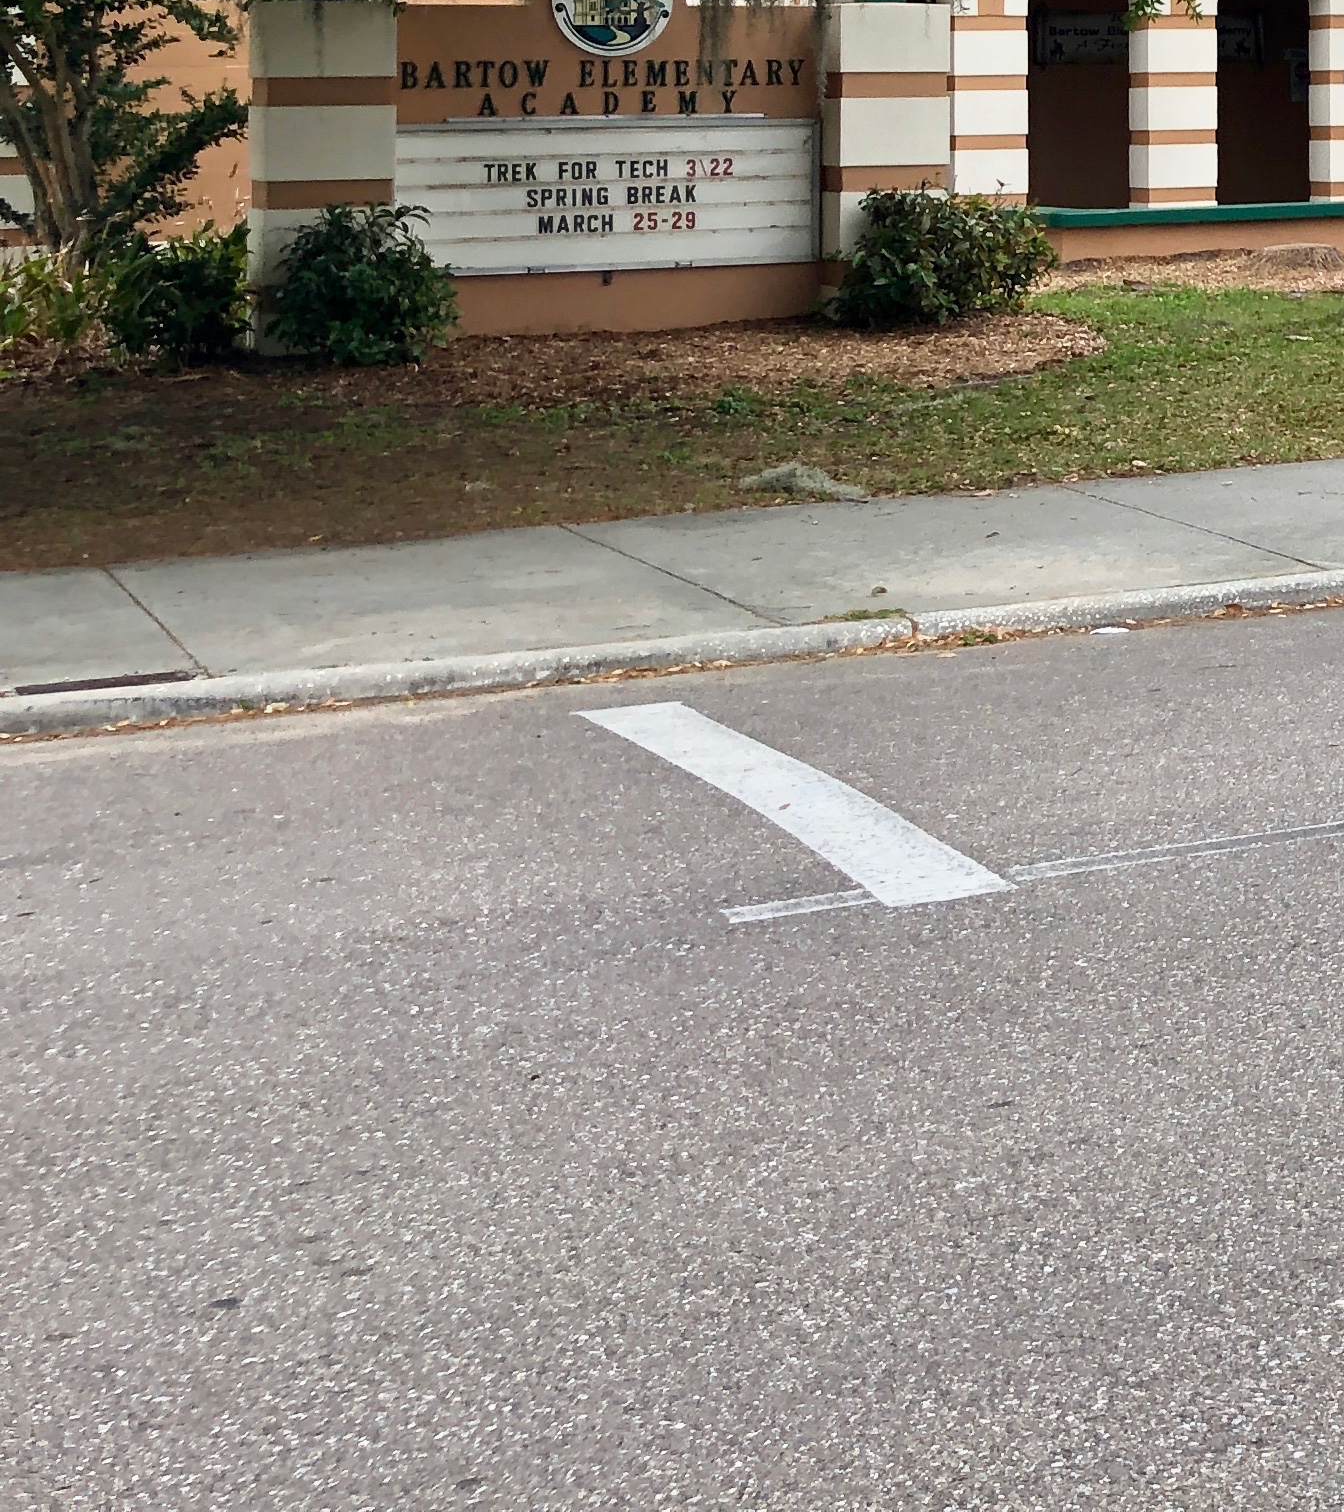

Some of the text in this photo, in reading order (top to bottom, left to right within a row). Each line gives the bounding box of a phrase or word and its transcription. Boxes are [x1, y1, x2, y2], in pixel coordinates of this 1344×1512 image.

[401, 59, 806, 89] BARTOW ELEMENTARY
[477, 90, 738, 116] ACADEMY
[484, 158, 734, 183] TREK FOR TECH 3\22
[526, 185, 697, 208] SPRING BREAK
[538, 211, 696, 234] MARCH 25-29
